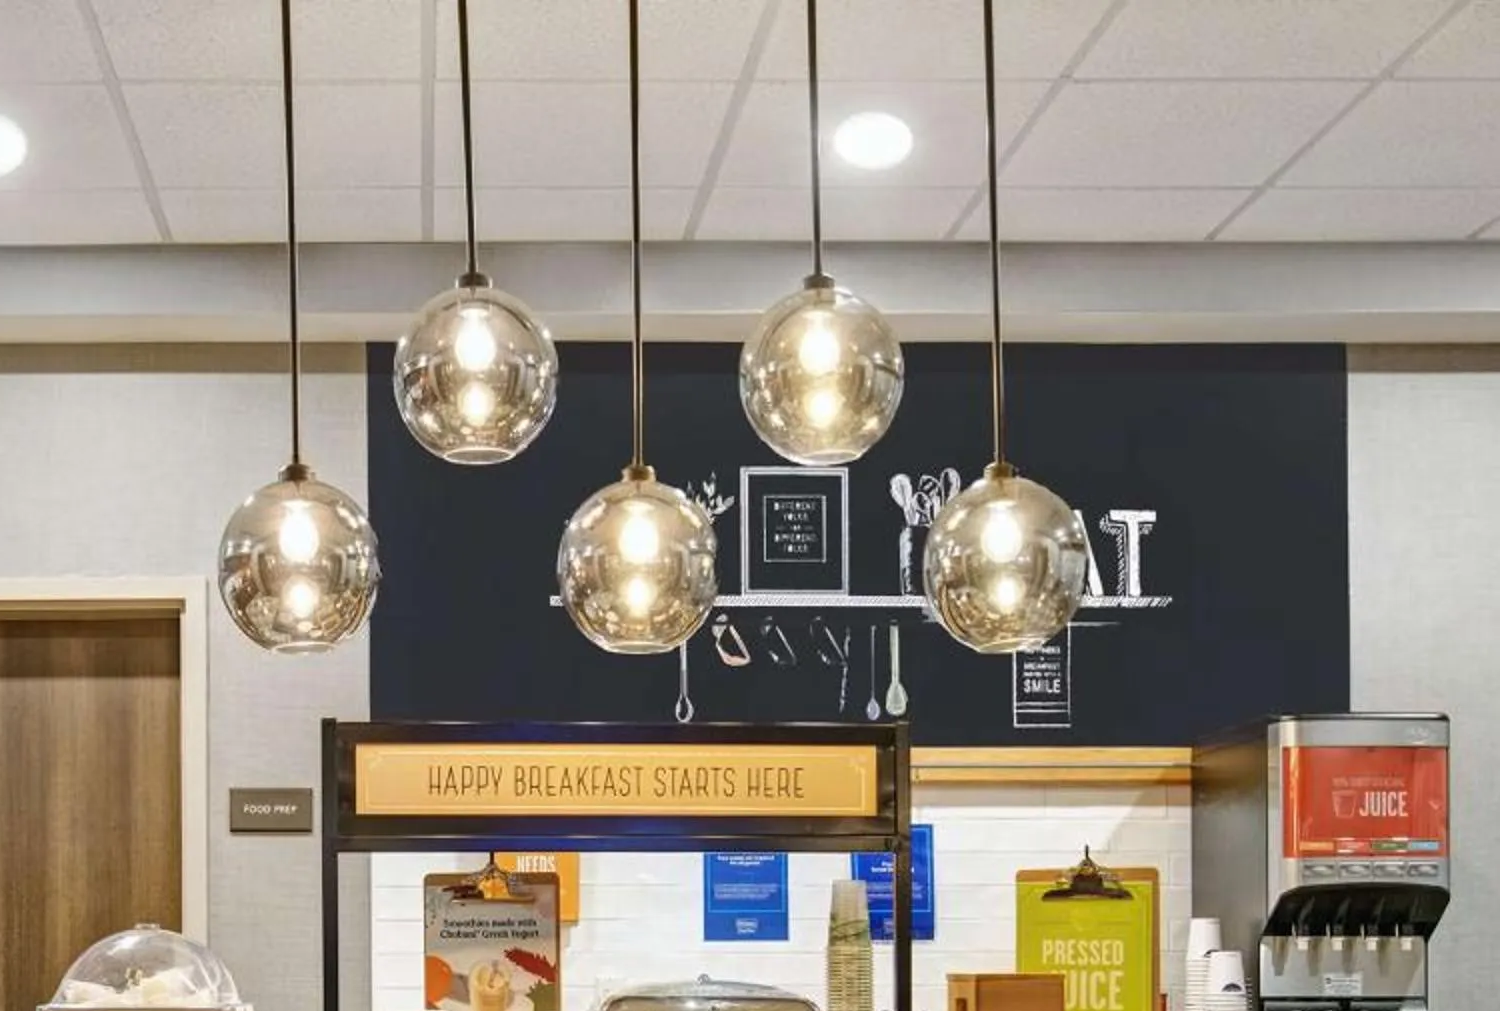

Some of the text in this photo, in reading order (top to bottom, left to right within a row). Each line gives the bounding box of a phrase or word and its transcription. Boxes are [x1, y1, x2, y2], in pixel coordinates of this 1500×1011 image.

[1023, 679, 1061, 693] SMILE
[428, 765, 805, 798] HAPPY BREAKFAST STARTS HERE
[243, 803, 298, 815] FOOD PREP
[1359, 791, 1409, 818] JUICE
[516, 855, 557, 873] NEEDS
[1042, 938, 1125, 966] PRESSED
